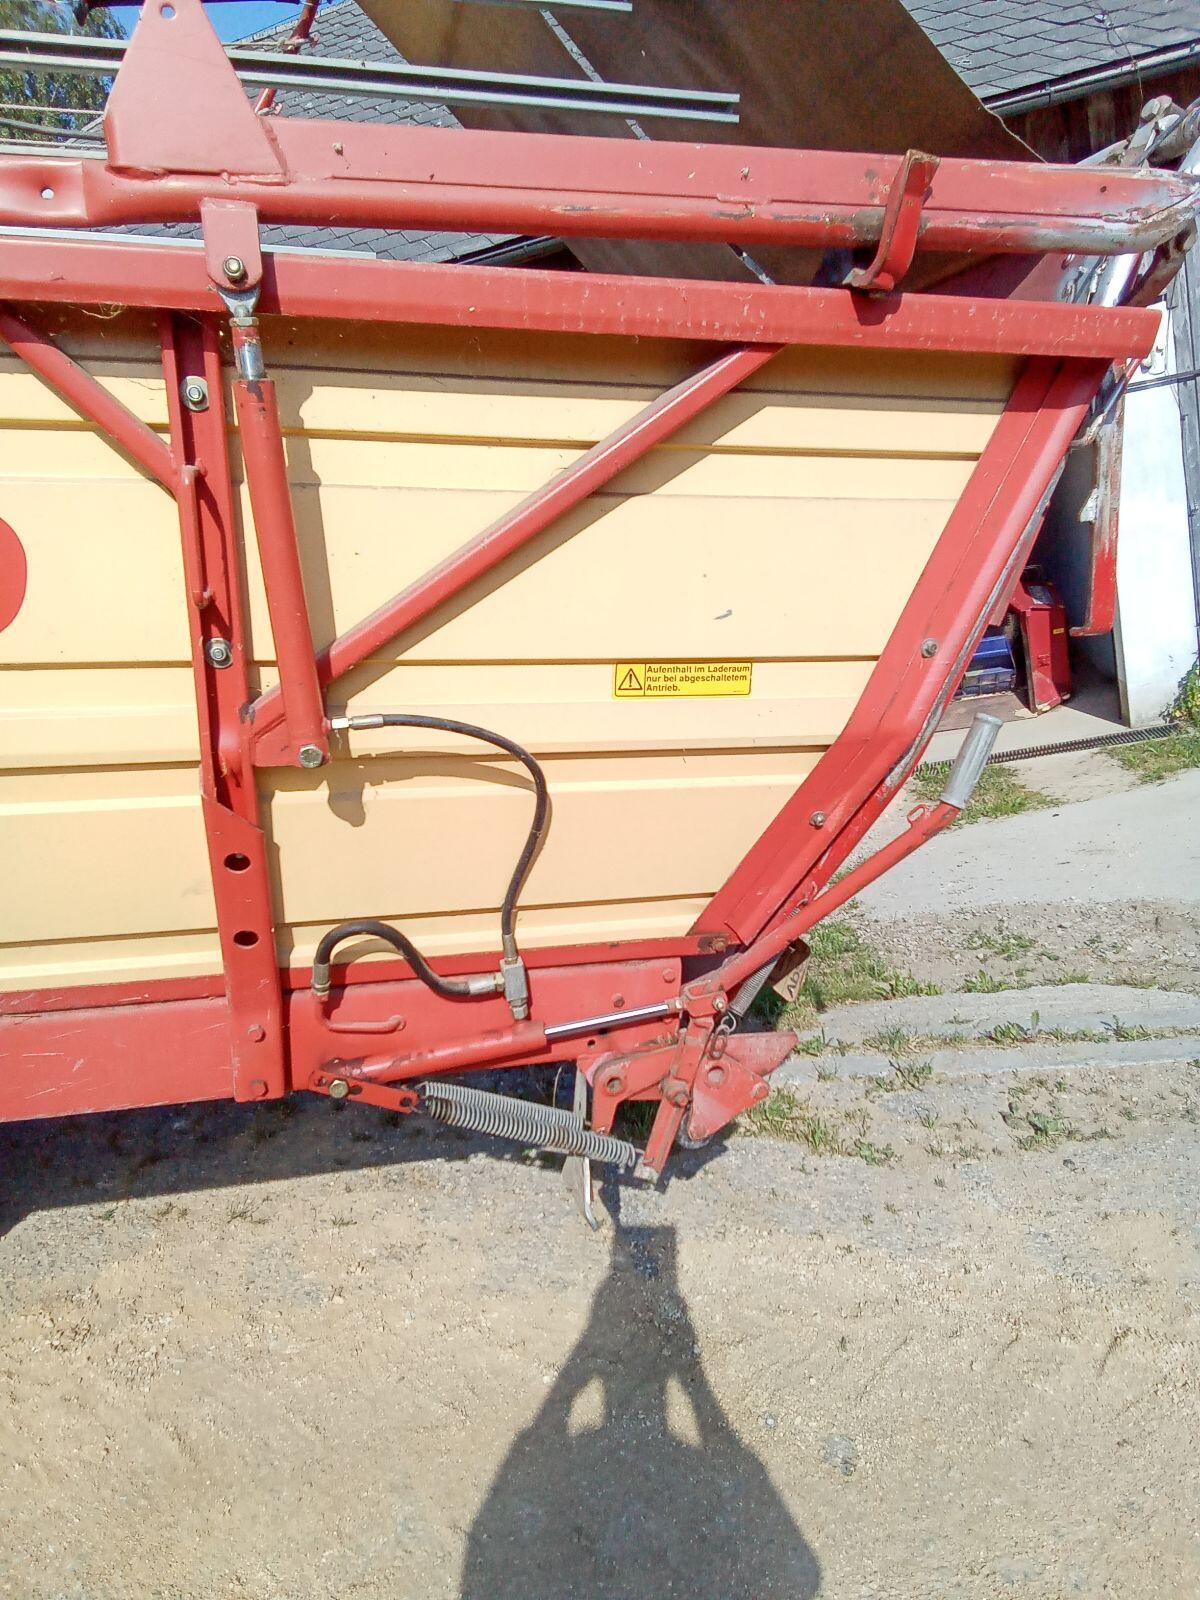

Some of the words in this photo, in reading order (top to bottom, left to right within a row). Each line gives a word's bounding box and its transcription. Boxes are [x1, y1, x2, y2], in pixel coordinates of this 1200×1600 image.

[694, 665, 705, 673] im
[707, 665, 750, 673] Laderaum
[679, 674, 747, 683] abgeschaltetem
[646, 684, 681, 692] Antrieb.
